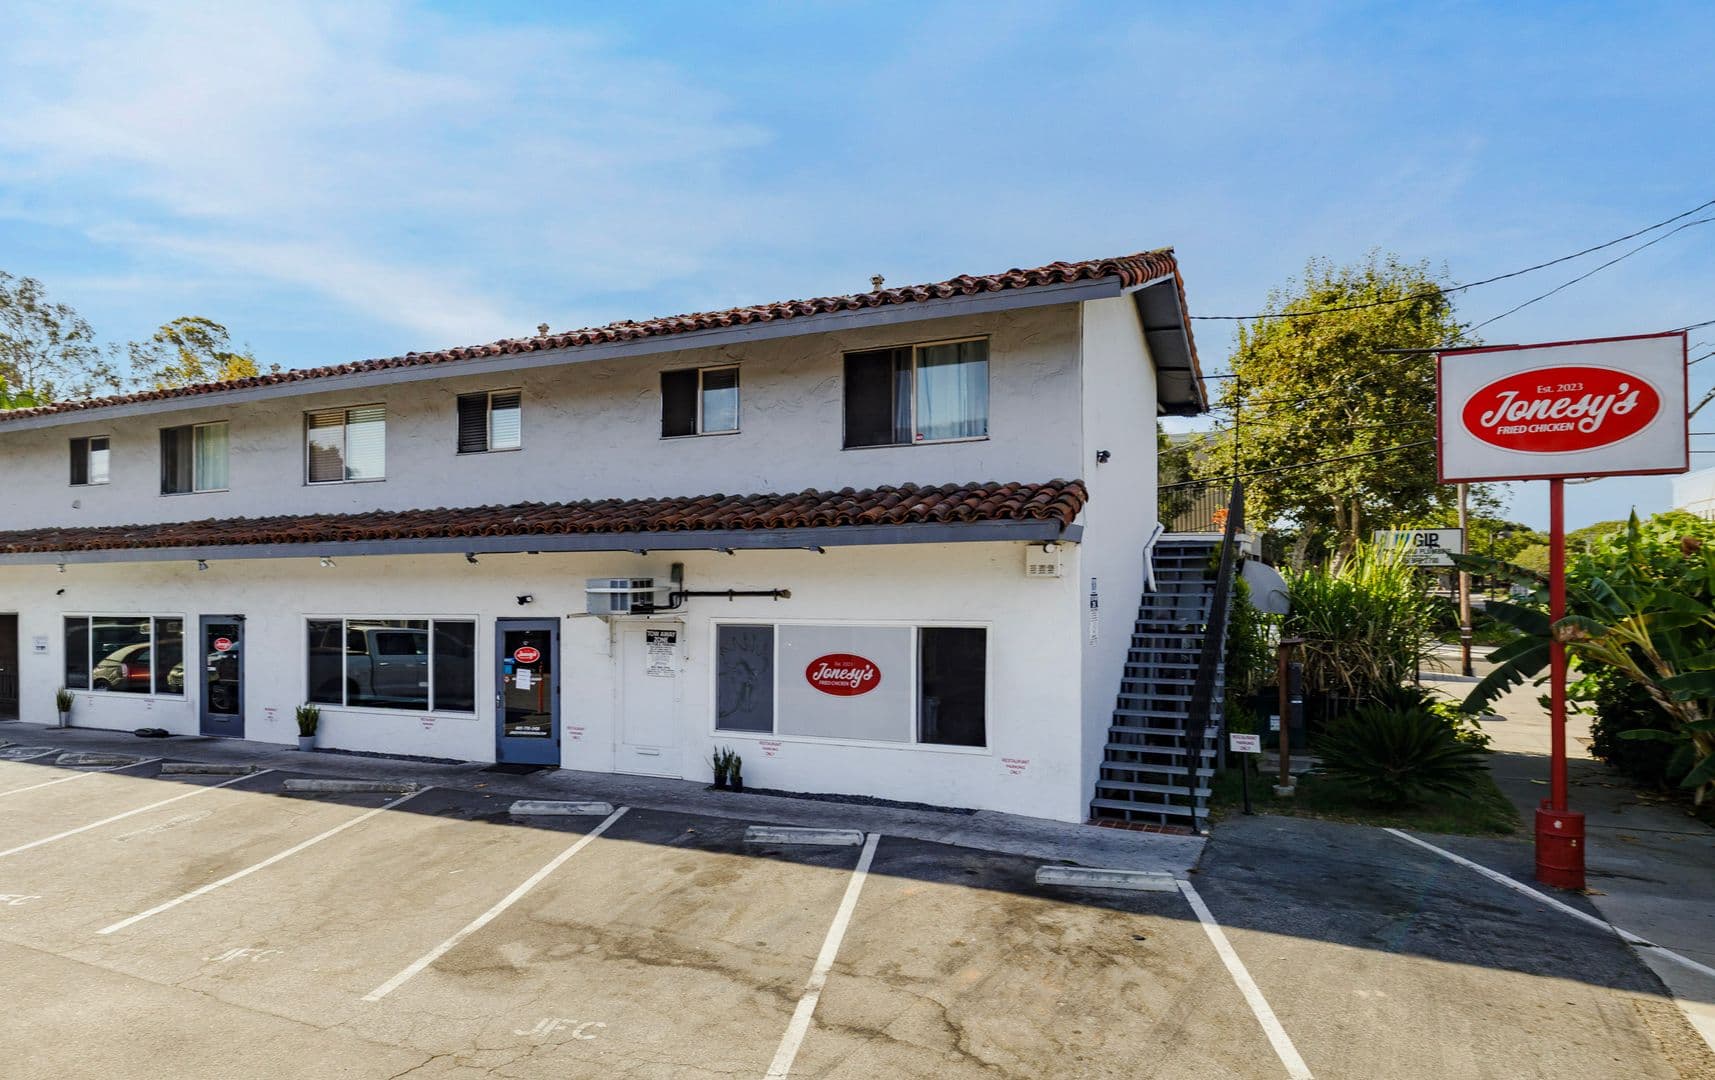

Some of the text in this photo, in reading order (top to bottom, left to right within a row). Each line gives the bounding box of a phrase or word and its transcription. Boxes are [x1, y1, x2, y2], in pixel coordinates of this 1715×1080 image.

[1536, 382, 1584, 394] Est. 2023
[1480, 382, 1641, 434] Jonesy's
[1496, 422, 1575, 435] FRIED CHICKEN
[812, 662, 874, 688] Jonesy's
[512, 1018, 608, 1041] JFC
